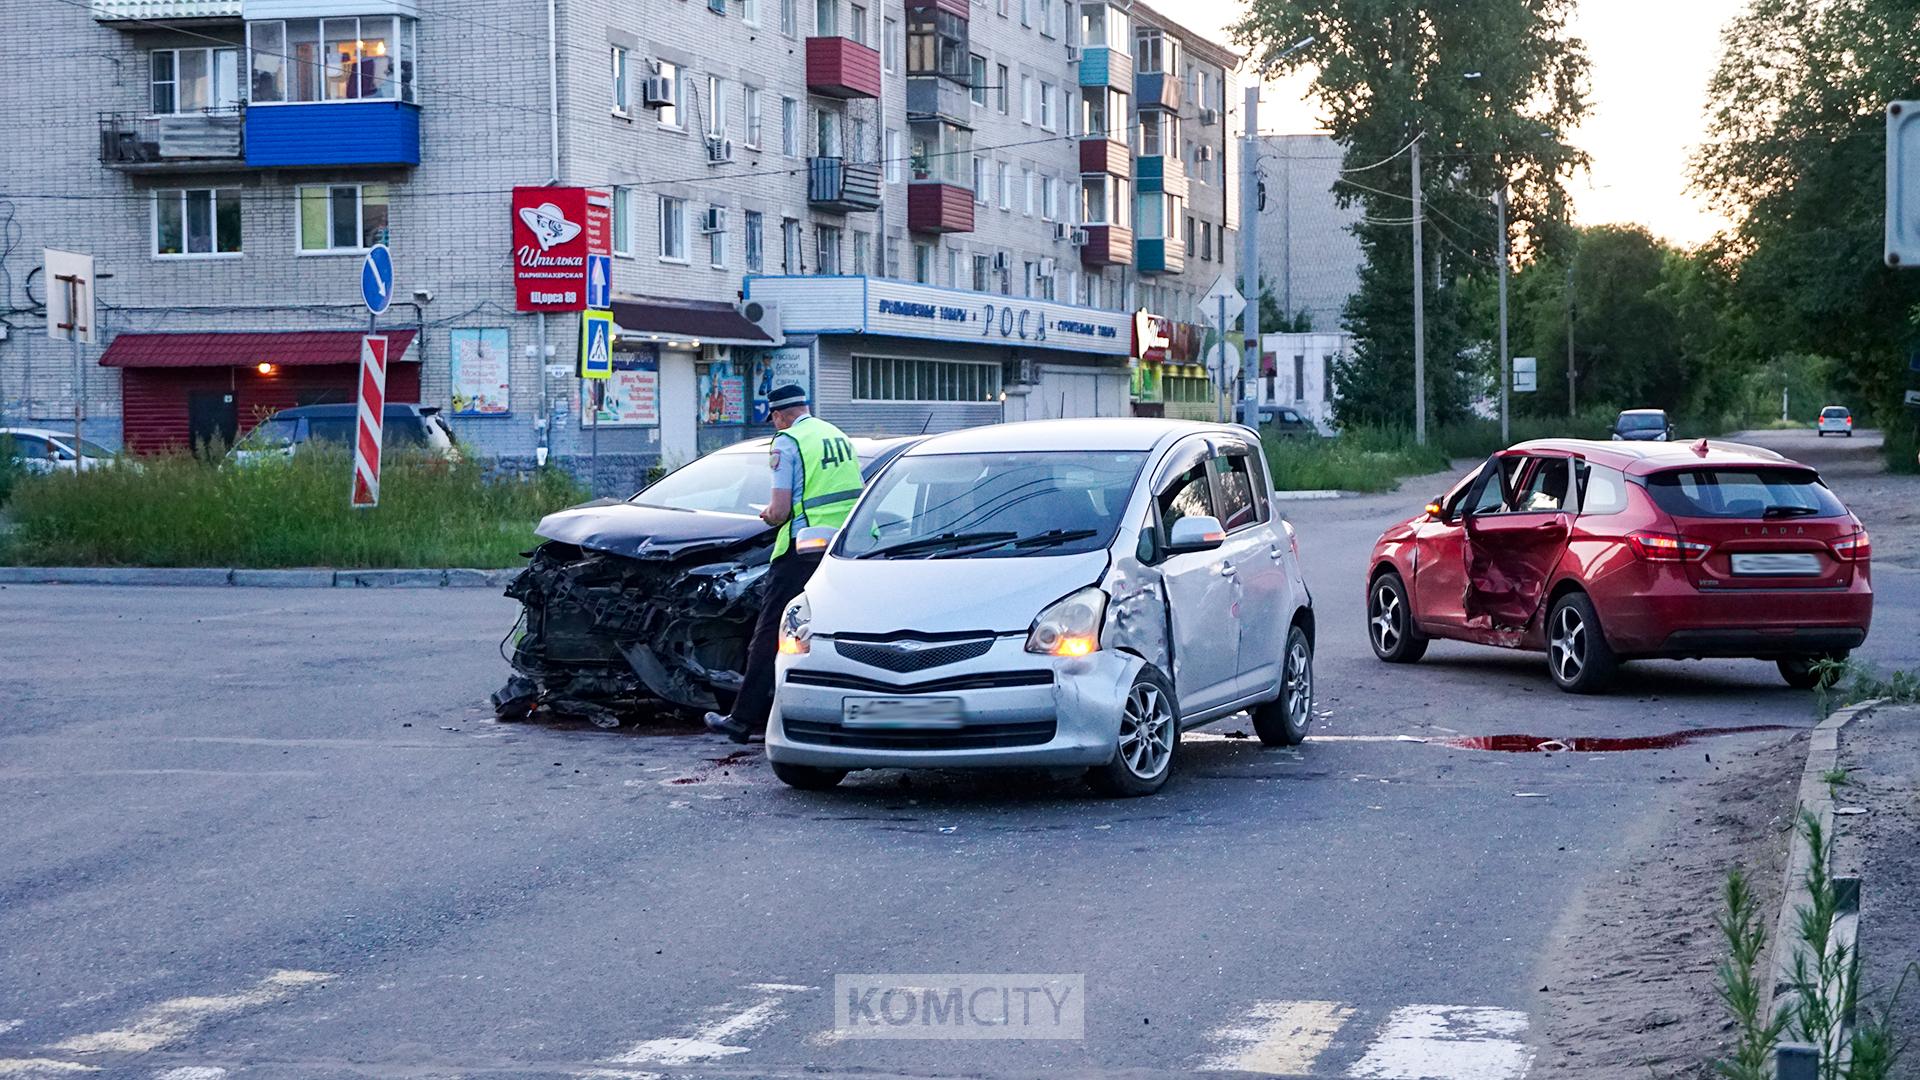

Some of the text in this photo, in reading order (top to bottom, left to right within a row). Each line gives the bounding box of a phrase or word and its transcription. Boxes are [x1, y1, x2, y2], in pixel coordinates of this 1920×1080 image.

[517, 245, 583, 267] Шпилька
[530, 291, 564, 304] Щорса
[982, 304, 1047, 341] РОСА
[821, 437, 853, 470] ДП
[1744, 527, 1804, 535] LADA
